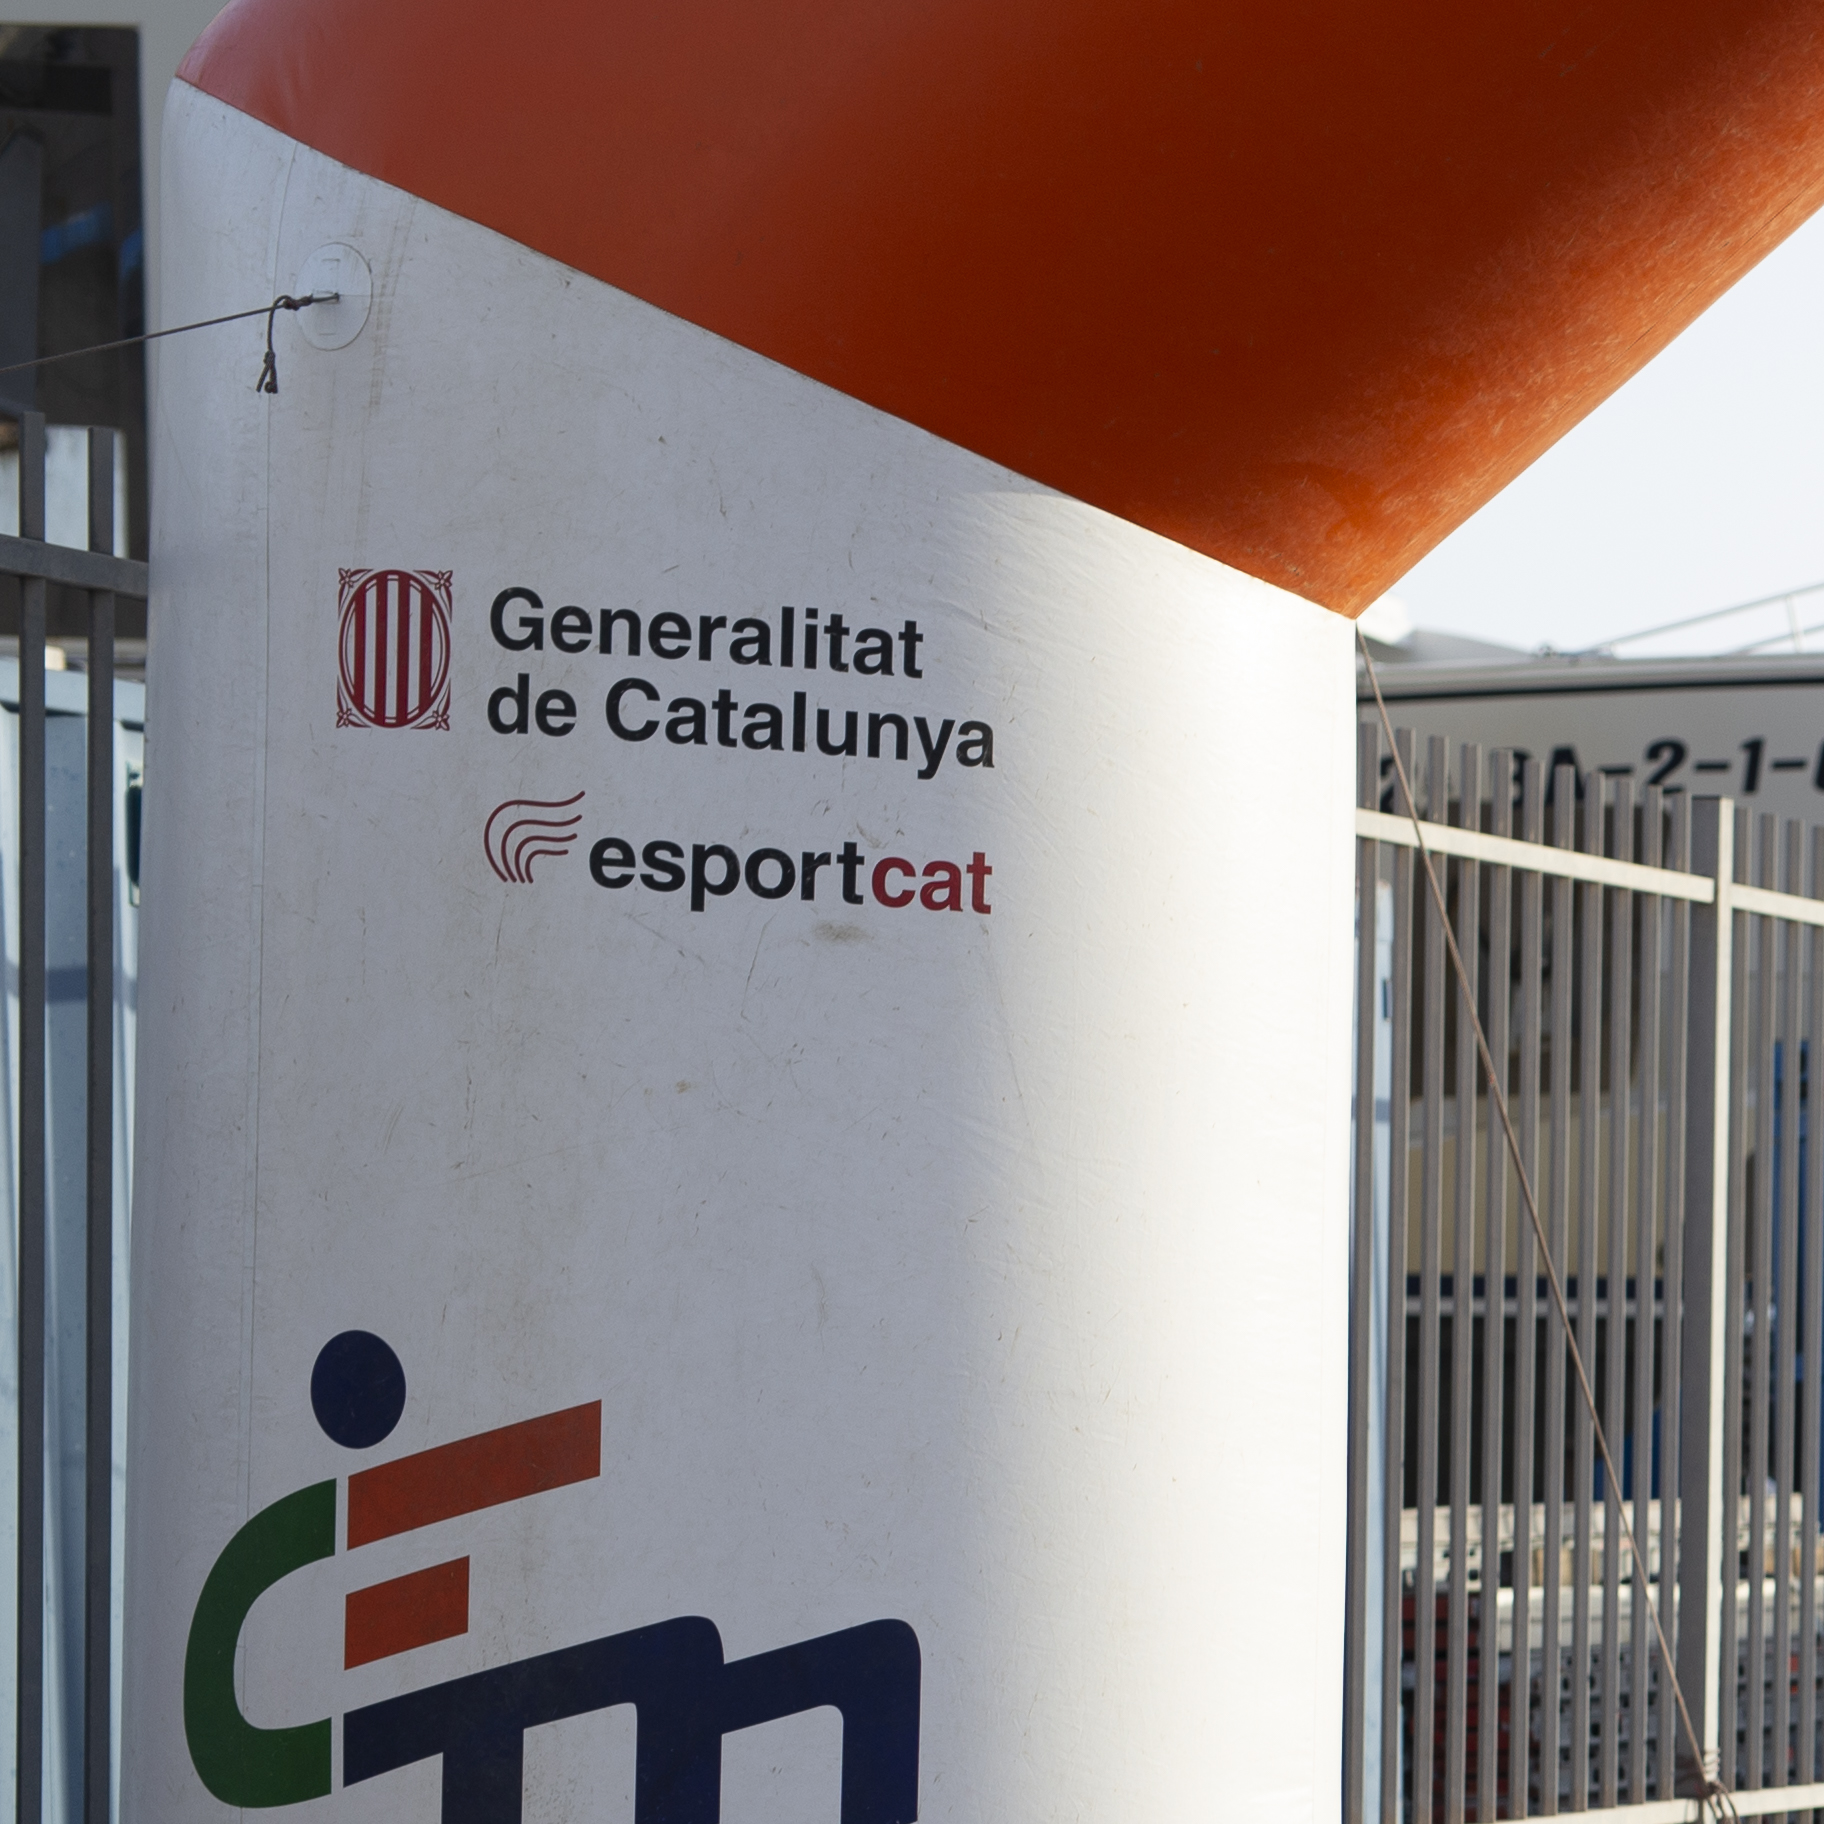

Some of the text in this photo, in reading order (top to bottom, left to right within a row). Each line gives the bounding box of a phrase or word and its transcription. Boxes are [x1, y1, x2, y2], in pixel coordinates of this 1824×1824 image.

[487, 584, 926, 680] Generalitat
[485, 670, 998, 782] de Catalunya
[587, 830, 995, 914] esportcat
